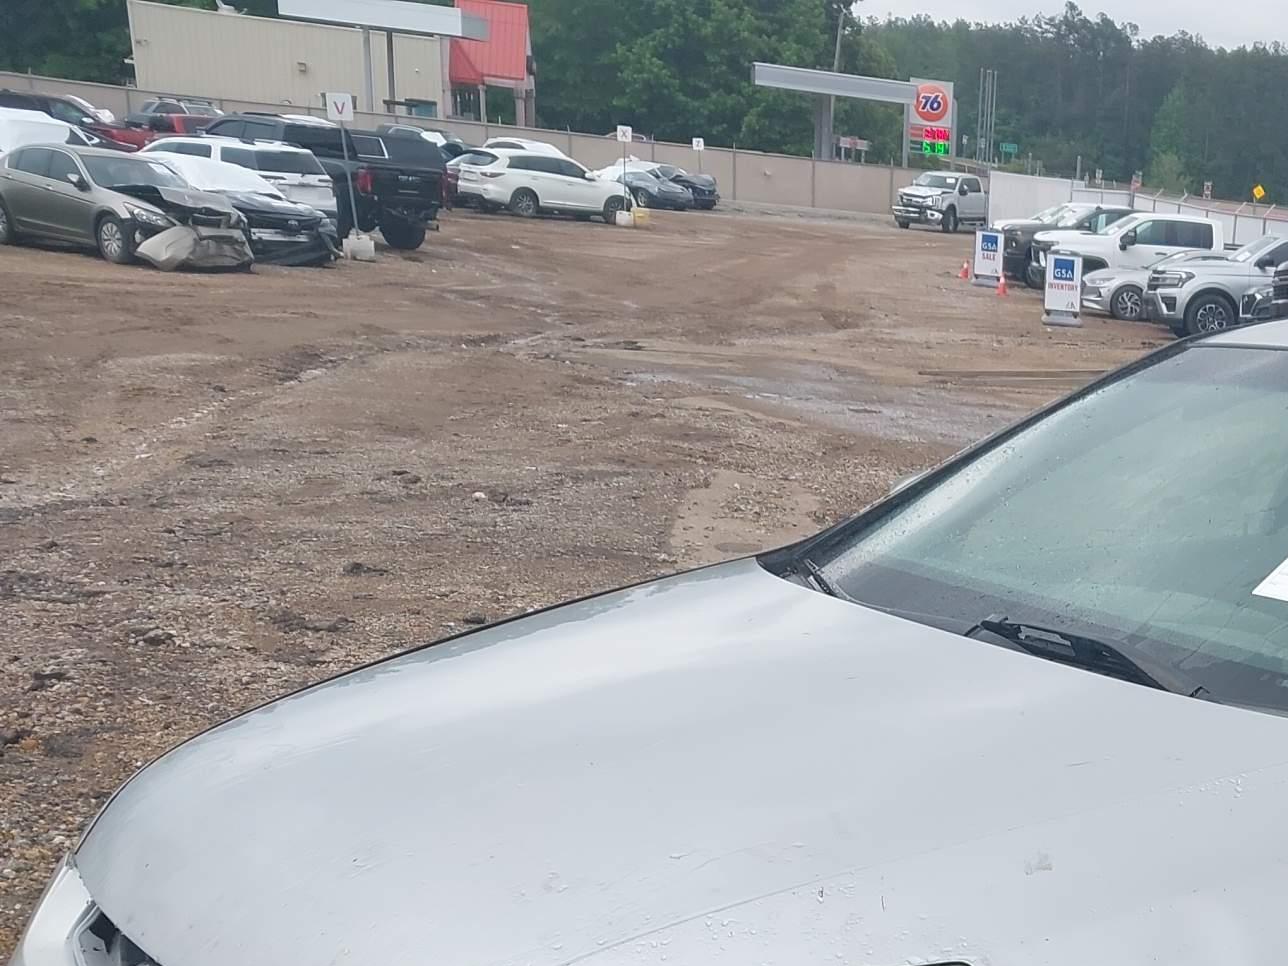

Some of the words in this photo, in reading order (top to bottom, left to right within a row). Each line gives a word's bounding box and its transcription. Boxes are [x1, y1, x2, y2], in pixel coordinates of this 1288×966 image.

[333, 101, 345, 114] V
[920, 94, 943, 113] 76
[982, 242, 997, 251] GSA
[982, 252, 996, 261] SALE
[1054, 269, 1073, 278] GSA
[1048, 283, 1078, 292] INVENTORY
